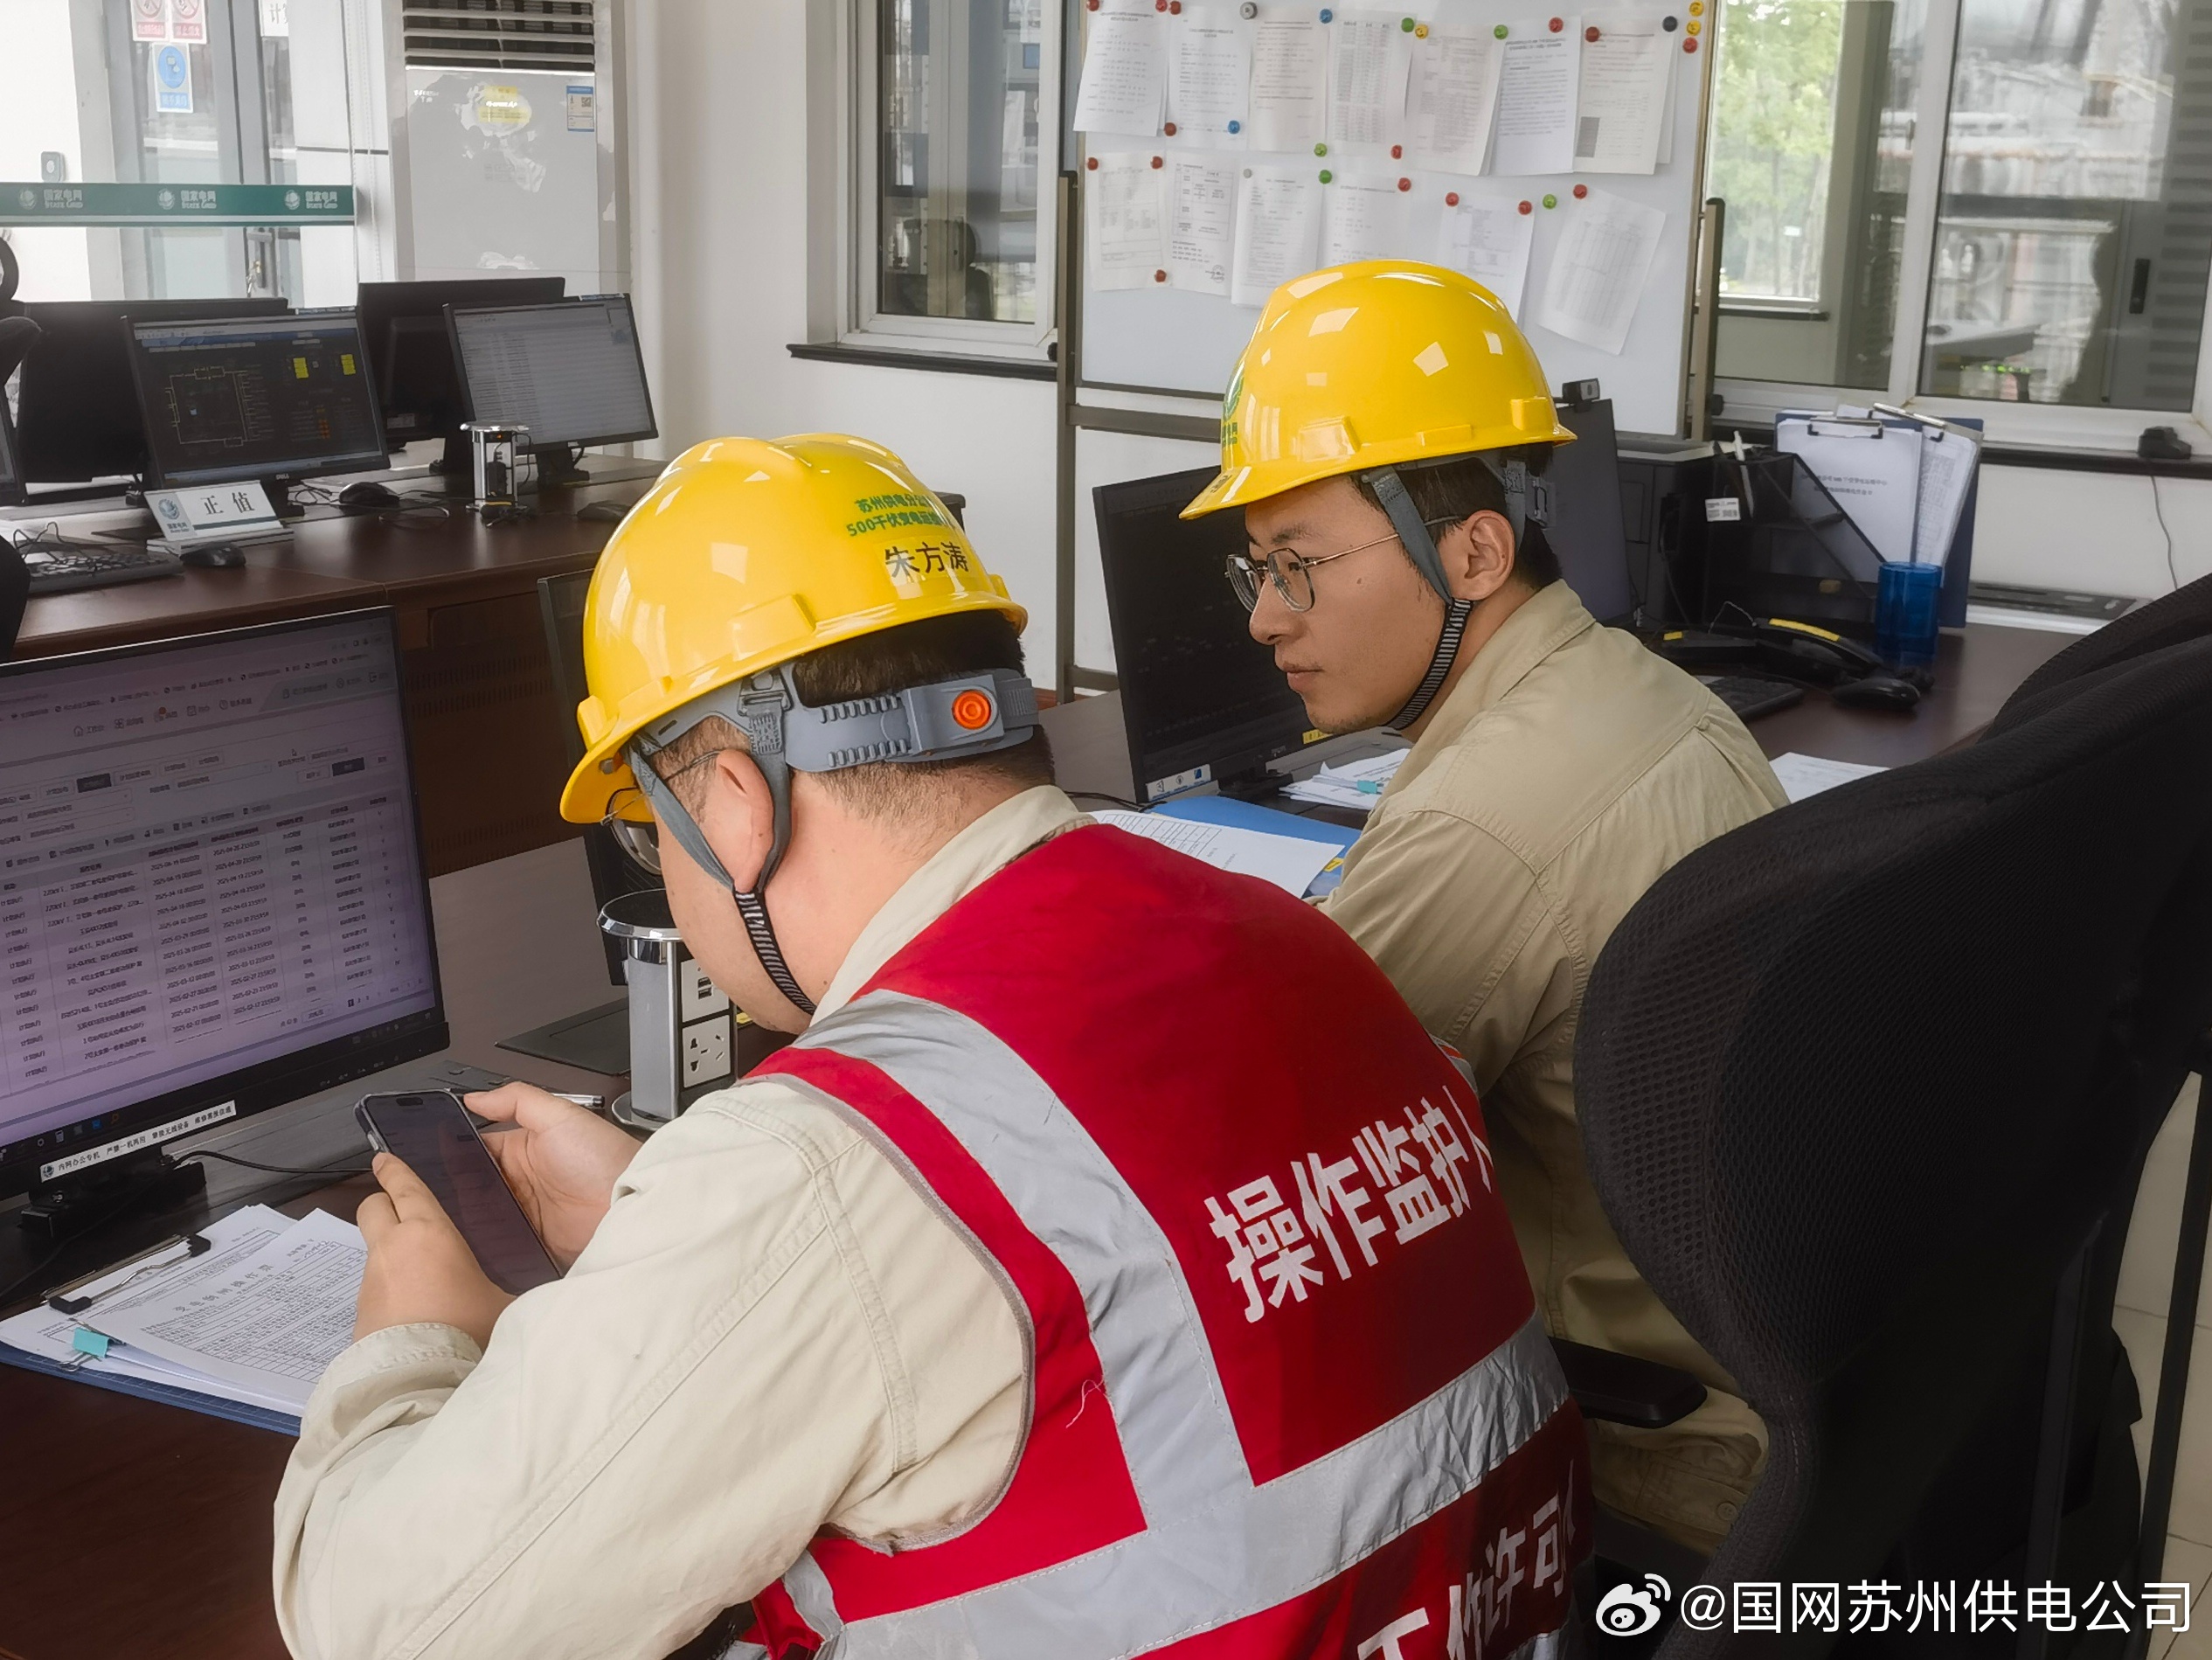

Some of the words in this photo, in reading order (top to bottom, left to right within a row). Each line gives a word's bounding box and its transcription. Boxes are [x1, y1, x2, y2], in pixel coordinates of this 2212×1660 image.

[200, 491, 256, 516] 正值
[884, 541, 969, 583] 朱方涛
[1204, 1085, 1494, 1323] 操作监护人
